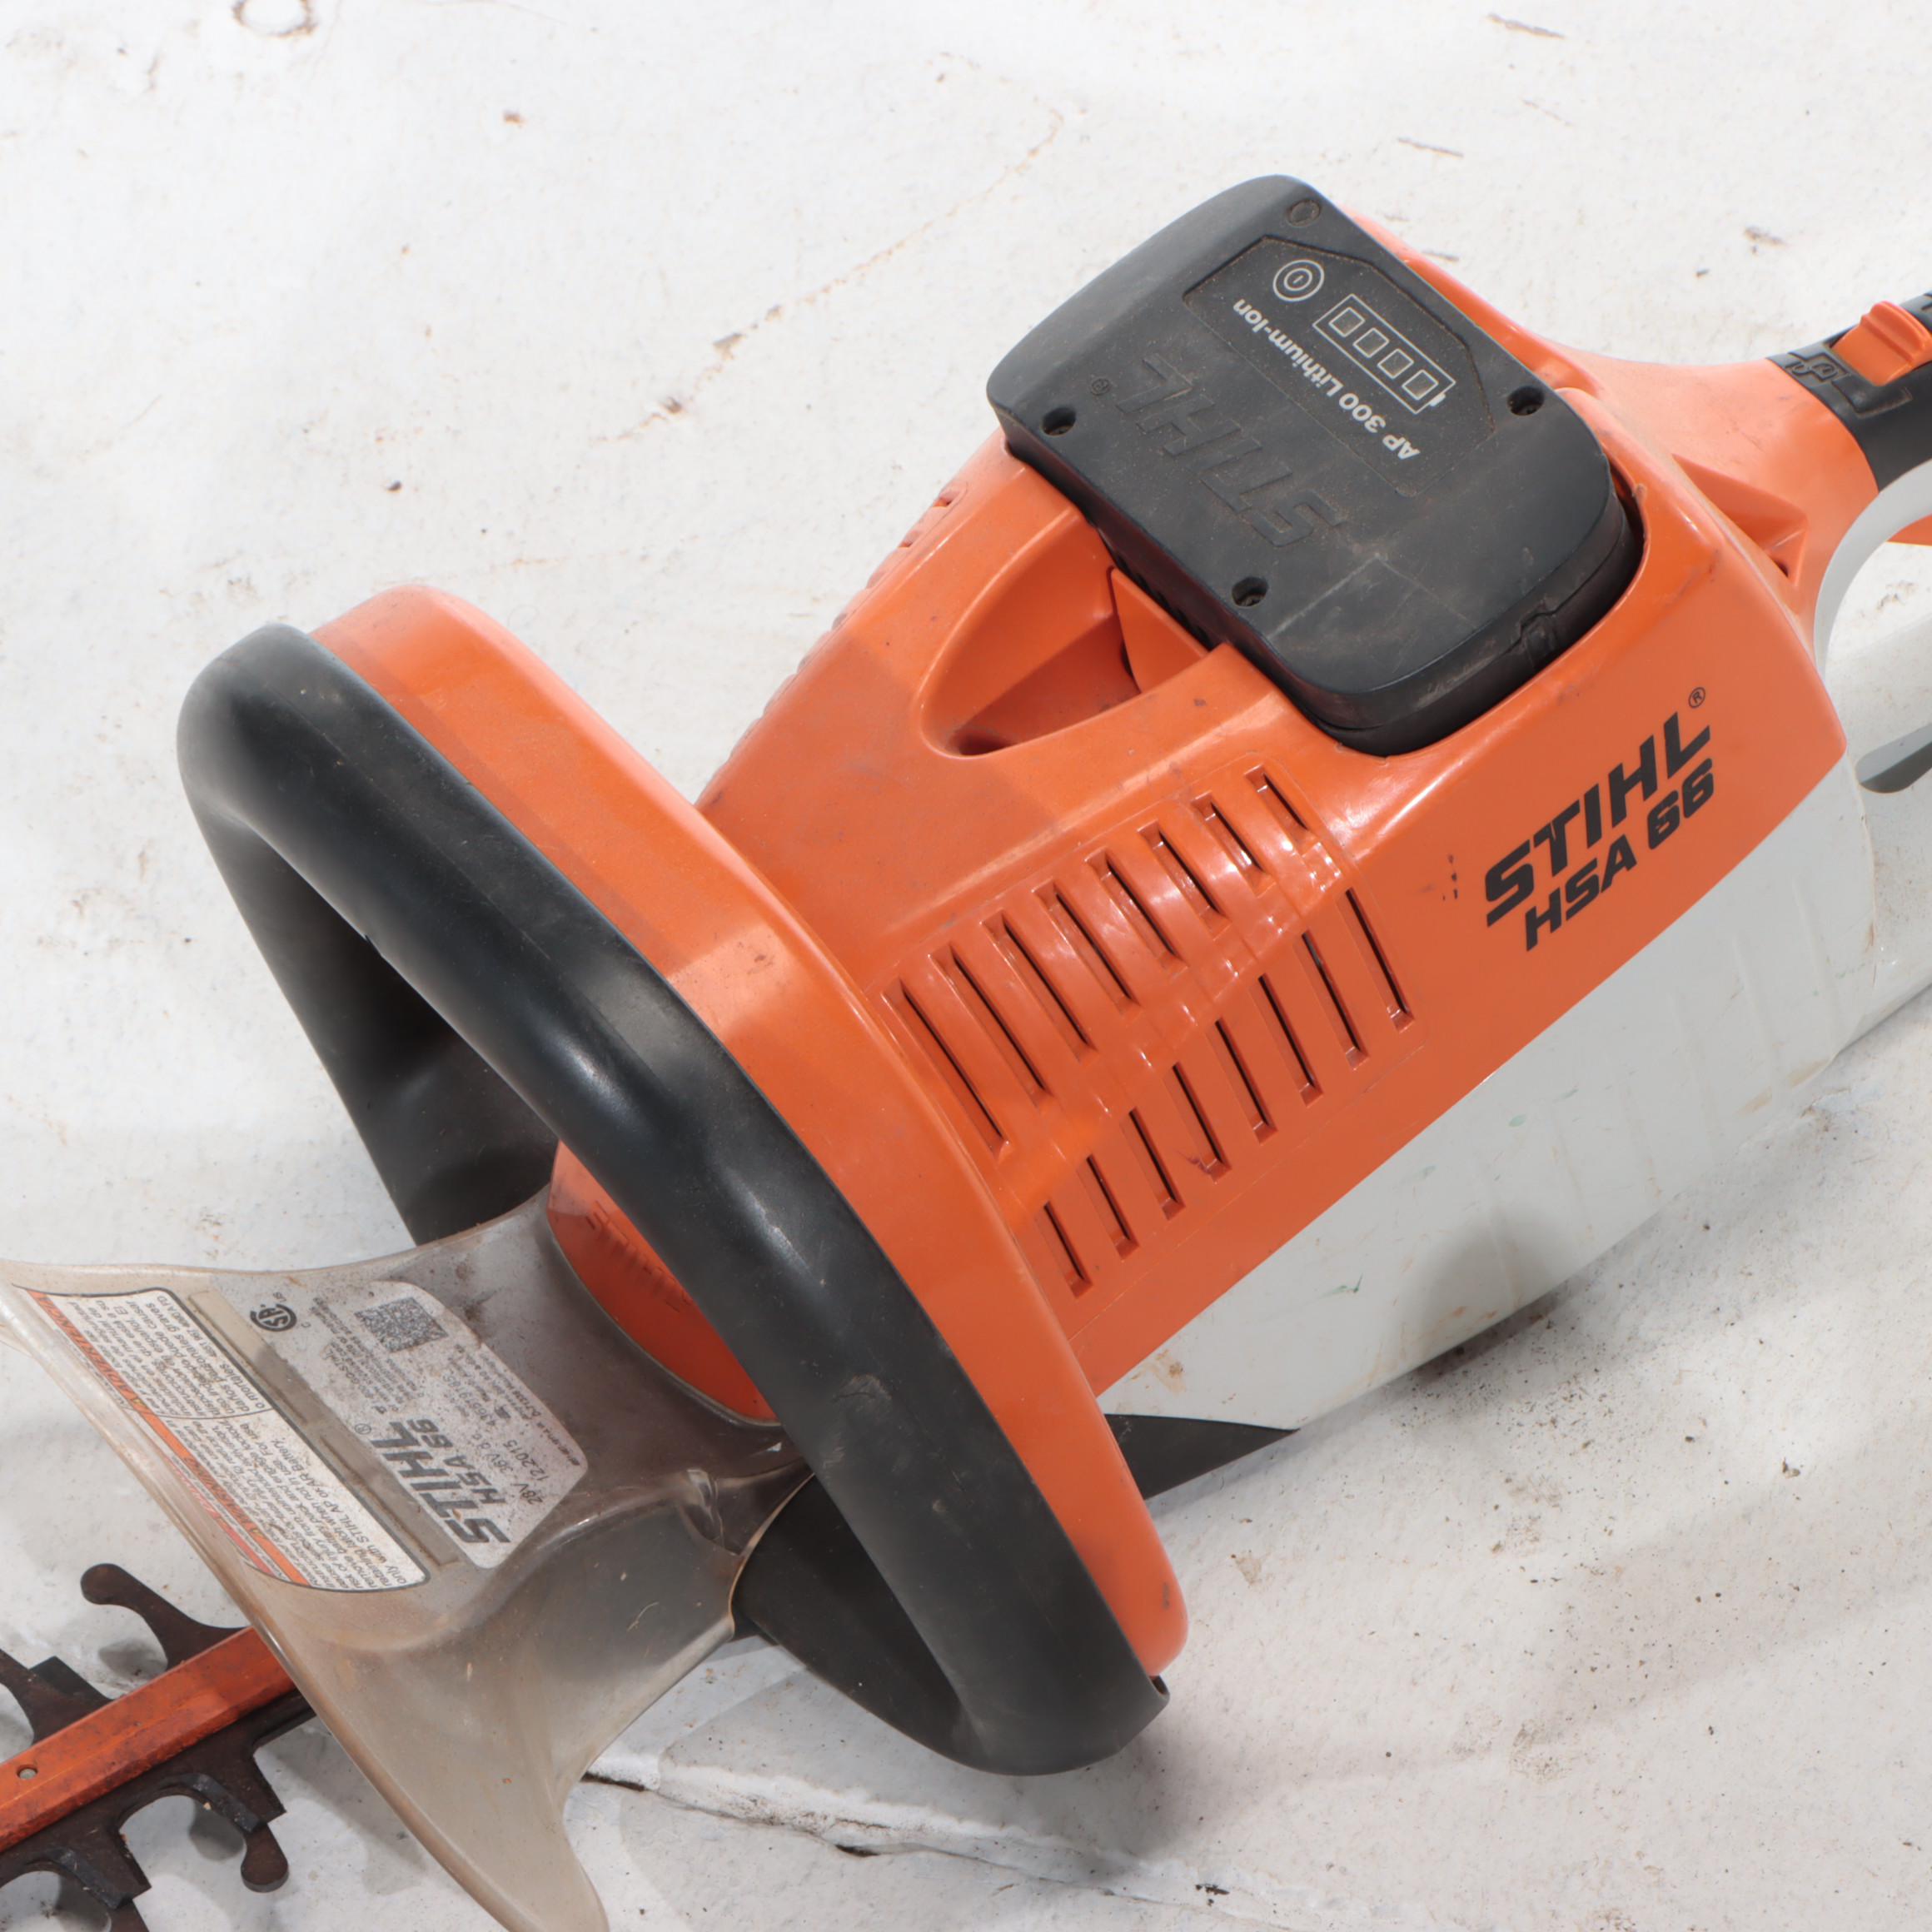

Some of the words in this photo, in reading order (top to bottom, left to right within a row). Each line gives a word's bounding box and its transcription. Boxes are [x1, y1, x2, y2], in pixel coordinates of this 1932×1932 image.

[1232, 298, 1344, 397] Lithium-Ion
[1338, 393, 1386, 433] 300
[1116, 353, 1347, 548] STIHL
[1382, 434, 1421, 460] AP
[1485, 711, 1710, 928] STIHL
[1525, 834, 1637, 952] HSA
[1647, 758, 1714, 849] 66
[35, 1297, 132, 1392] ADVERTENCIA
[406, 1419, 453, 1447] 66
[183, 1458, 251, 1521] WARNING
[276, 1486, 298, 1500] and
[371, 1422, 511, 1543] STIHL
[443, 1455, 506, 1504] HSA
[515, 1481, 542, 1506] 28V
[276, 1545, 298, 1561] and
